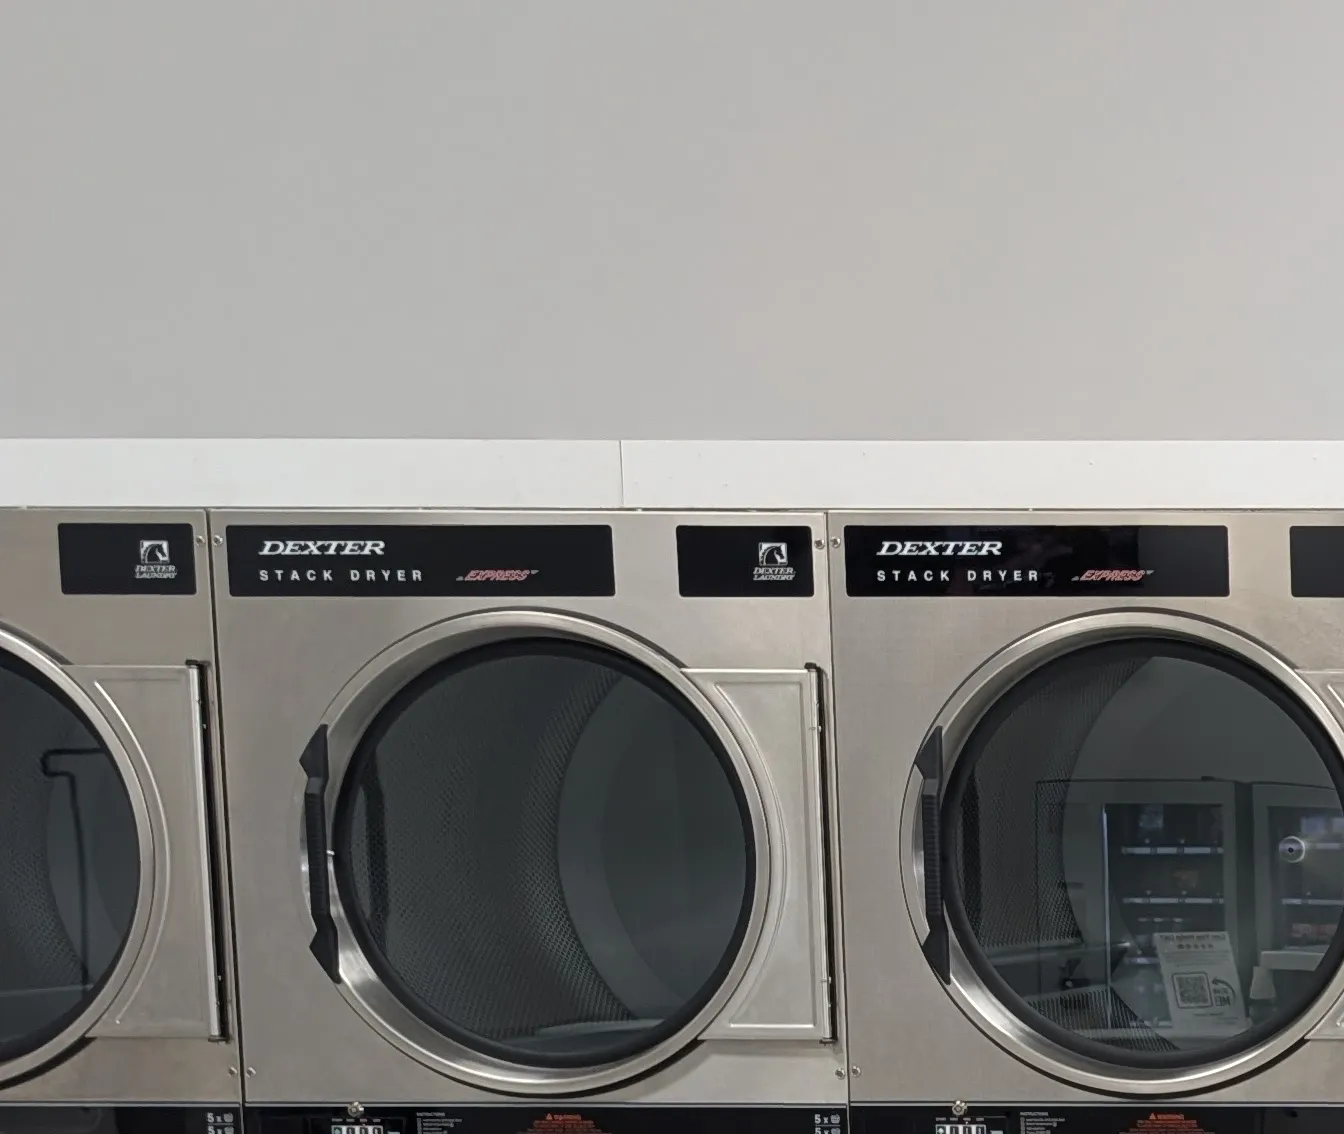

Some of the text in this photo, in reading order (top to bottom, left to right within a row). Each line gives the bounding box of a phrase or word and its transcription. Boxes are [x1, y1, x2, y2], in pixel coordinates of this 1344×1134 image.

[258, 540, 386, 556] DEXTER
[876, 540, 1003, 556] DEXTER
[259, 569, 422, 582] STACK DRYER
[464, 570, 531, 582] EXPRESS
[753, 566, 793, 575] DEXTER
[876, 569, 1038, 582] STACK DRYER
[1080, 570, 1147, 582] EXPRESS
[207, 1113, 214, 1123] 5
[815, 1114, 822, 1124] 5
